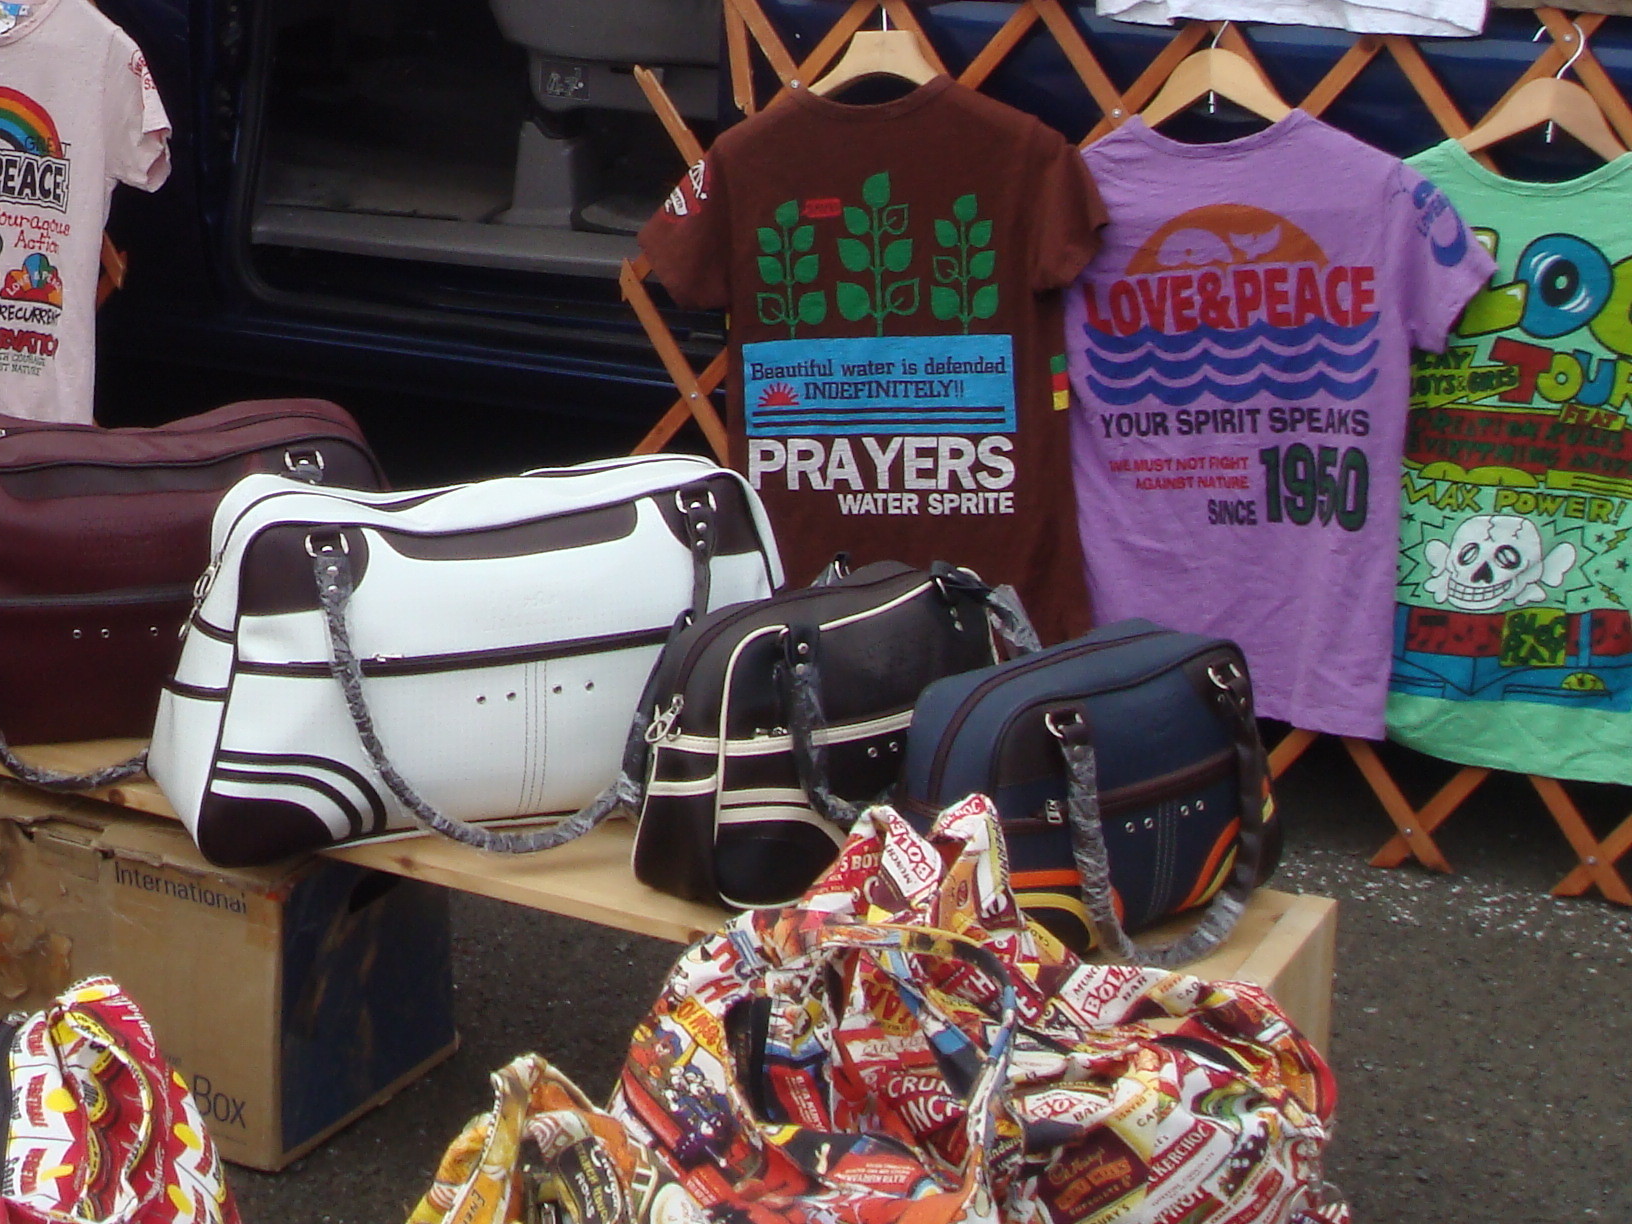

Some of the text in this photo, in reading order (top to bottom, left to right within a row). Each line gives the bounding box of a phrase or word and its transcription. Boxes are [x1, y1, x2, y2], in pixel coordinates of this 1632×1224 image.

[1082, 266, 1375, 337] LOVE&PEACE
[750, 356, 1006, 380] Beautiful water is defended
[804, 379, 964, 400] INDEFINITELY!!
[1100, 407, 1370, 438] YOUR SPIRIT SPEAKS
[748, 435, 1015, 491] PRAYERS
[1135, 458, 1171, 472] MUST
[1175, 457, 1206, 472] NOT
[1136, 476, 1249, 490] AGAINST NATURE
[1259, 442, 1369, 532] 1950
[838, 491, 1014, 515] WATER SPRITE
[1208, 499, 1257, 526] SINCE
[1494, 488, 1627, 525] POWER!
[887, 813, 936, 882] BOLE
[1122, 977, 1148, 1002] BAR
